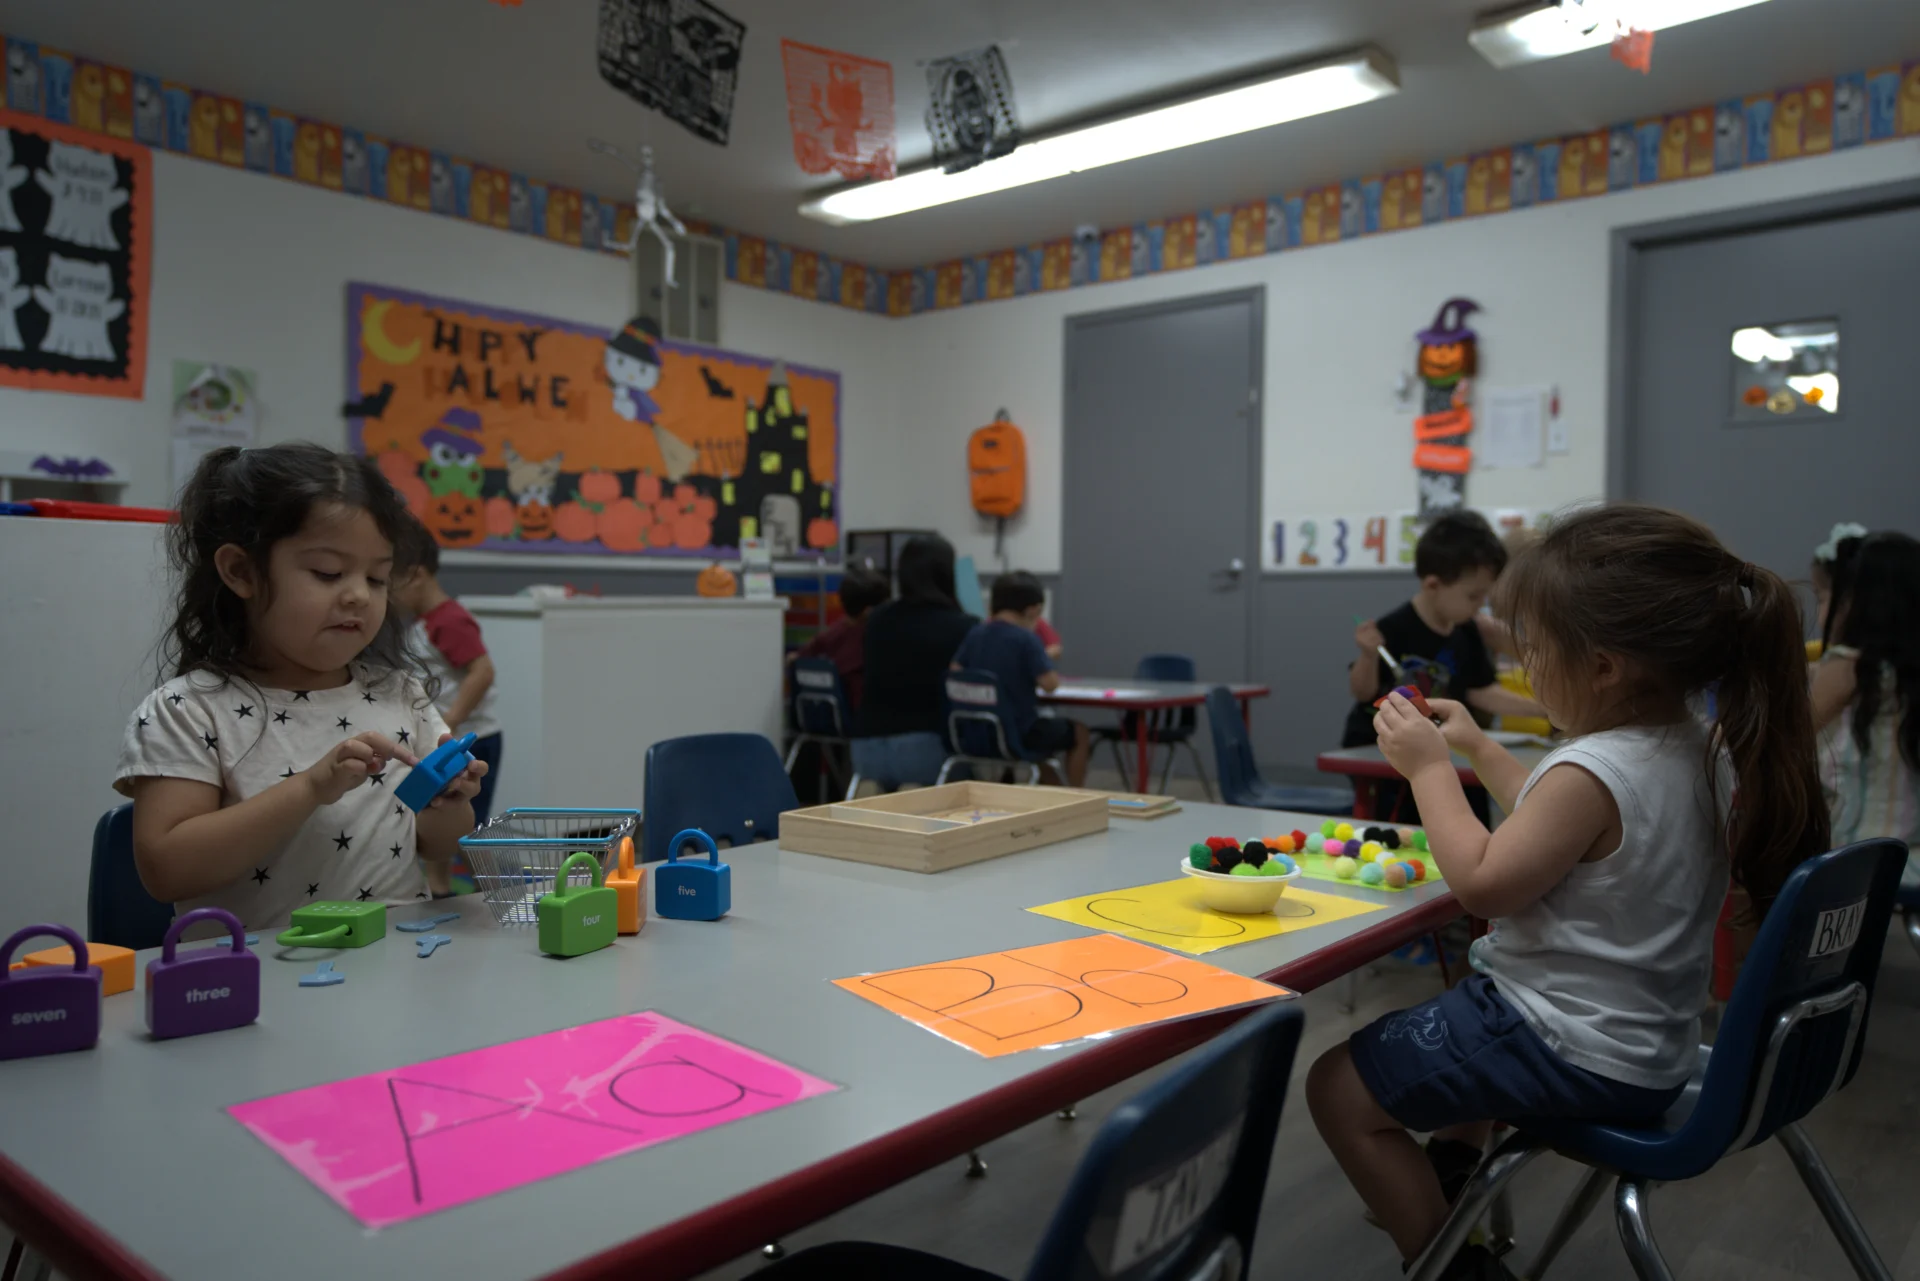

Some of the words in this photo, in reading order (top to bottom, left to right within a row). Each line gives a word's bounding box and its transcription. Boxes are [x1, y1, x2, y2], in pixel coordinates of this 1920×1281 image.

[1298, 520, 1319, 565] 2
[1334, 518, 1348, 565] 3
[1363, 516, 1387, 564] 4
[677, 885, 697, 897] five
[582, 914, 601, 927] four
[185, 986, 232, 1004] three
[11, 1008, 68, 1026] seven
[387, 1077, 645, 1205] A
